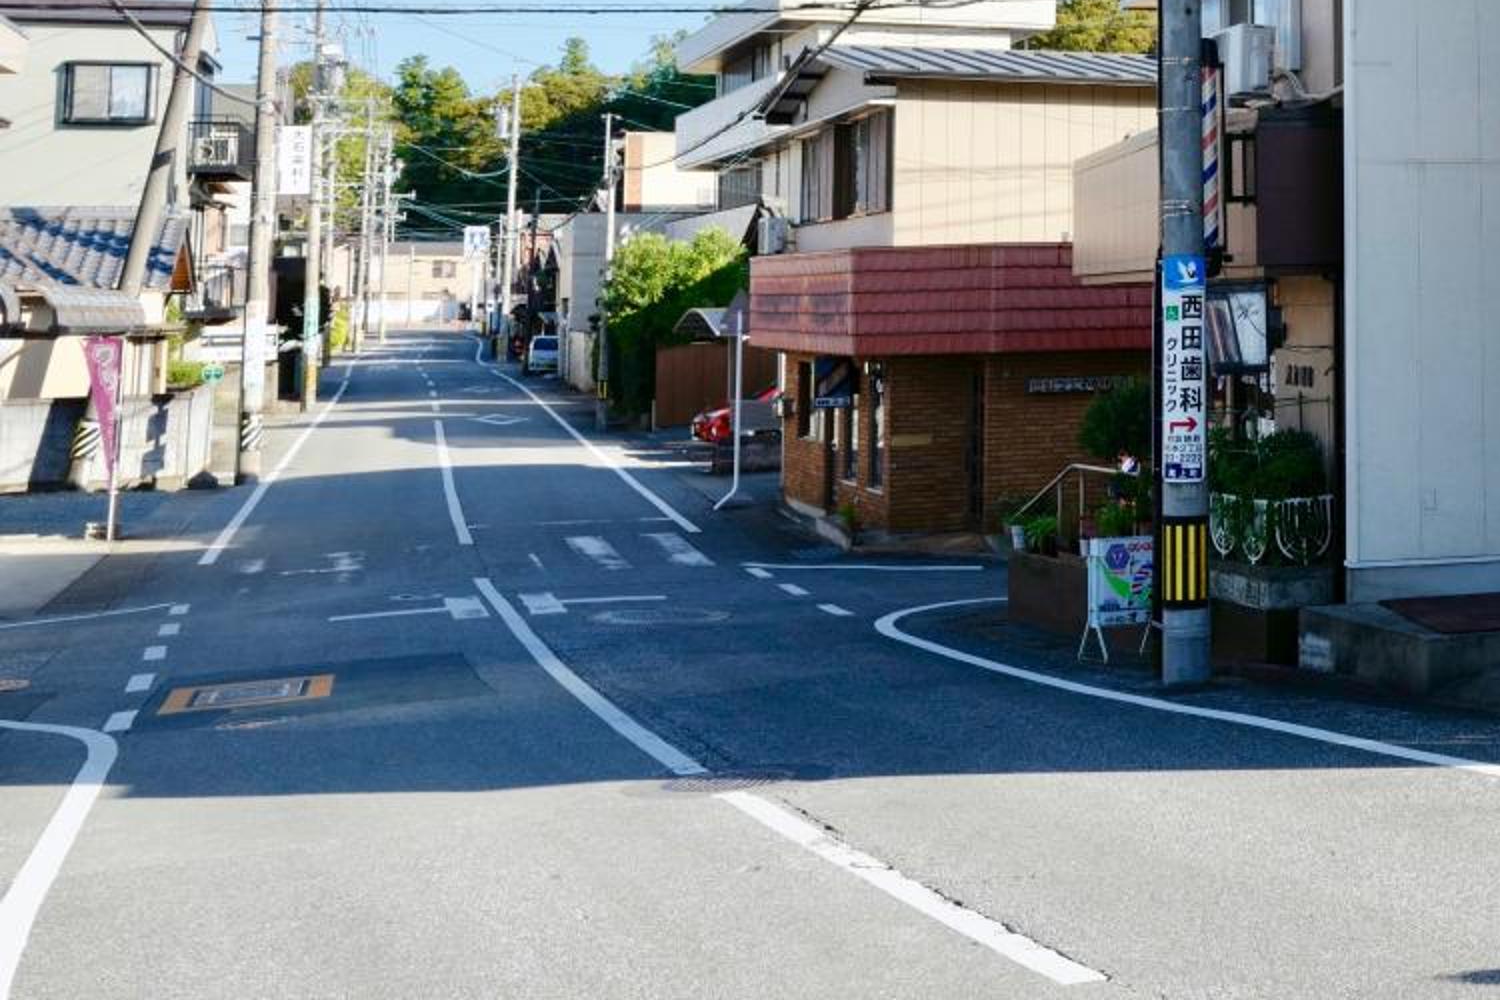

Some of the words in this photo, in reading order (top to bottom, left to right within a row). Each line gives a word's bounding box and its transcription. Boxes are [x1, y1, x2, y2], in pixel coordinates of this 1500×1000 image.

[1165, 337, 1178, 412] クリニック
[1180, 295, 1203, 412] 西田歯科
